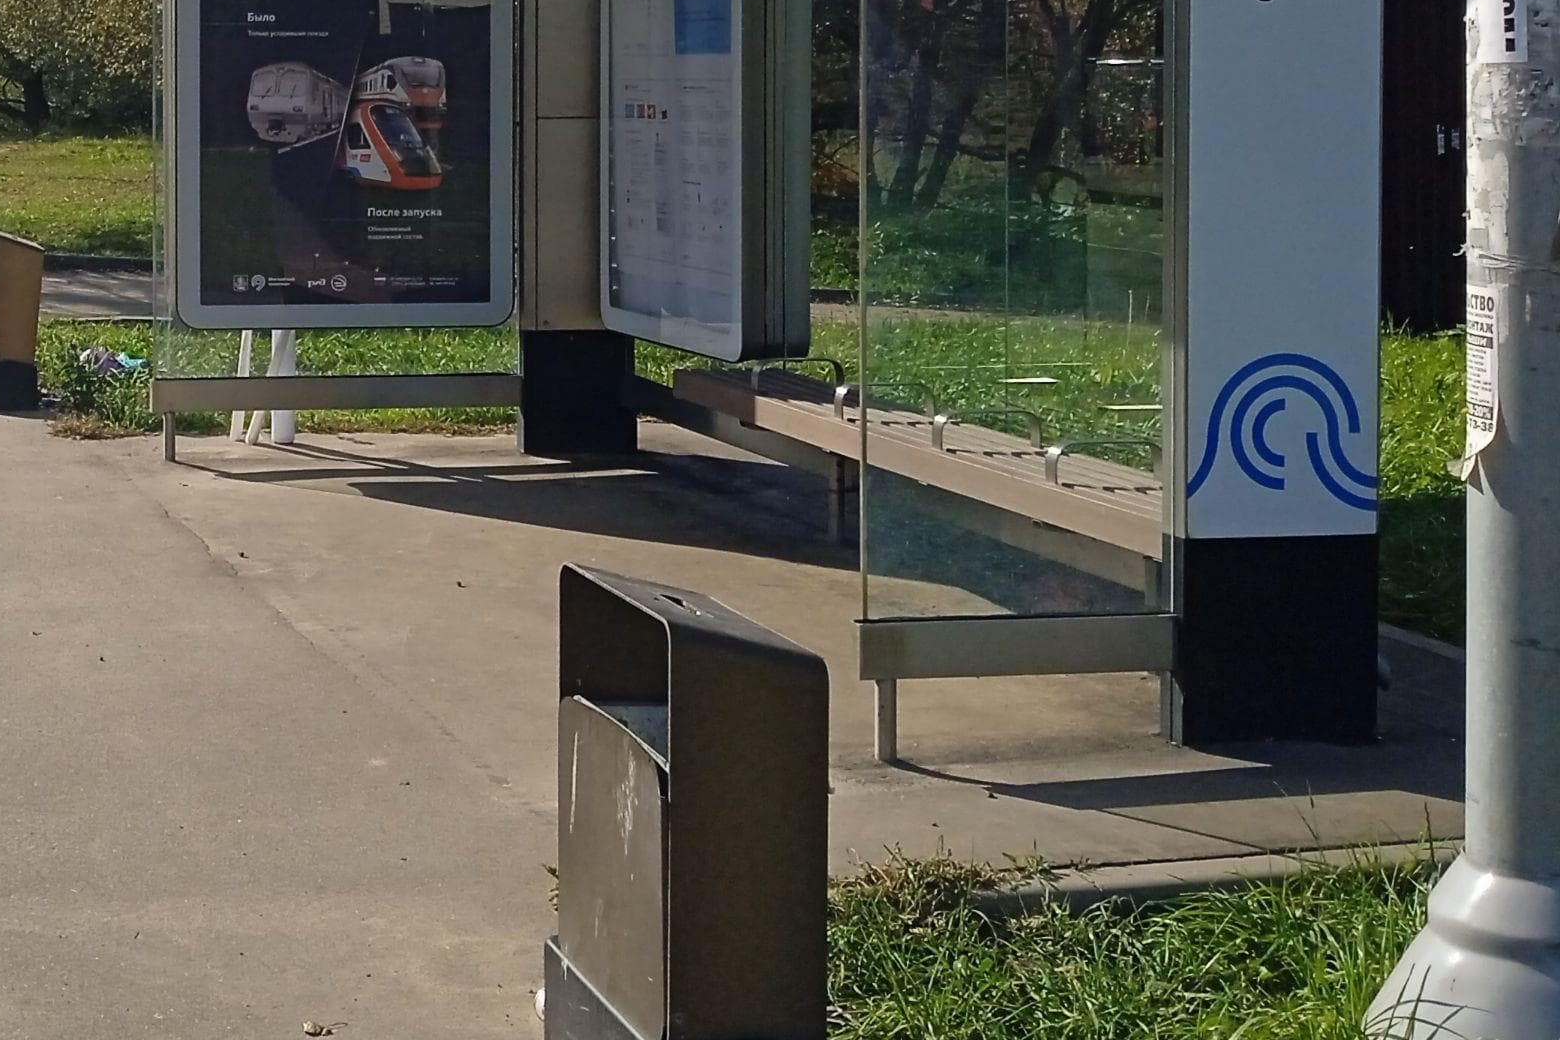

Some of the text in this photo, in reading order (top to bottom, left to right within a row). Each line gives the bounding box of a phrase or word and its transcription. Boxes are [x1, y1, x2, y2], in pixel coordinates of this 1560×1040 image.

[247, 12, 276, 22] Было
[367, 207, 443, 219] После запуска
